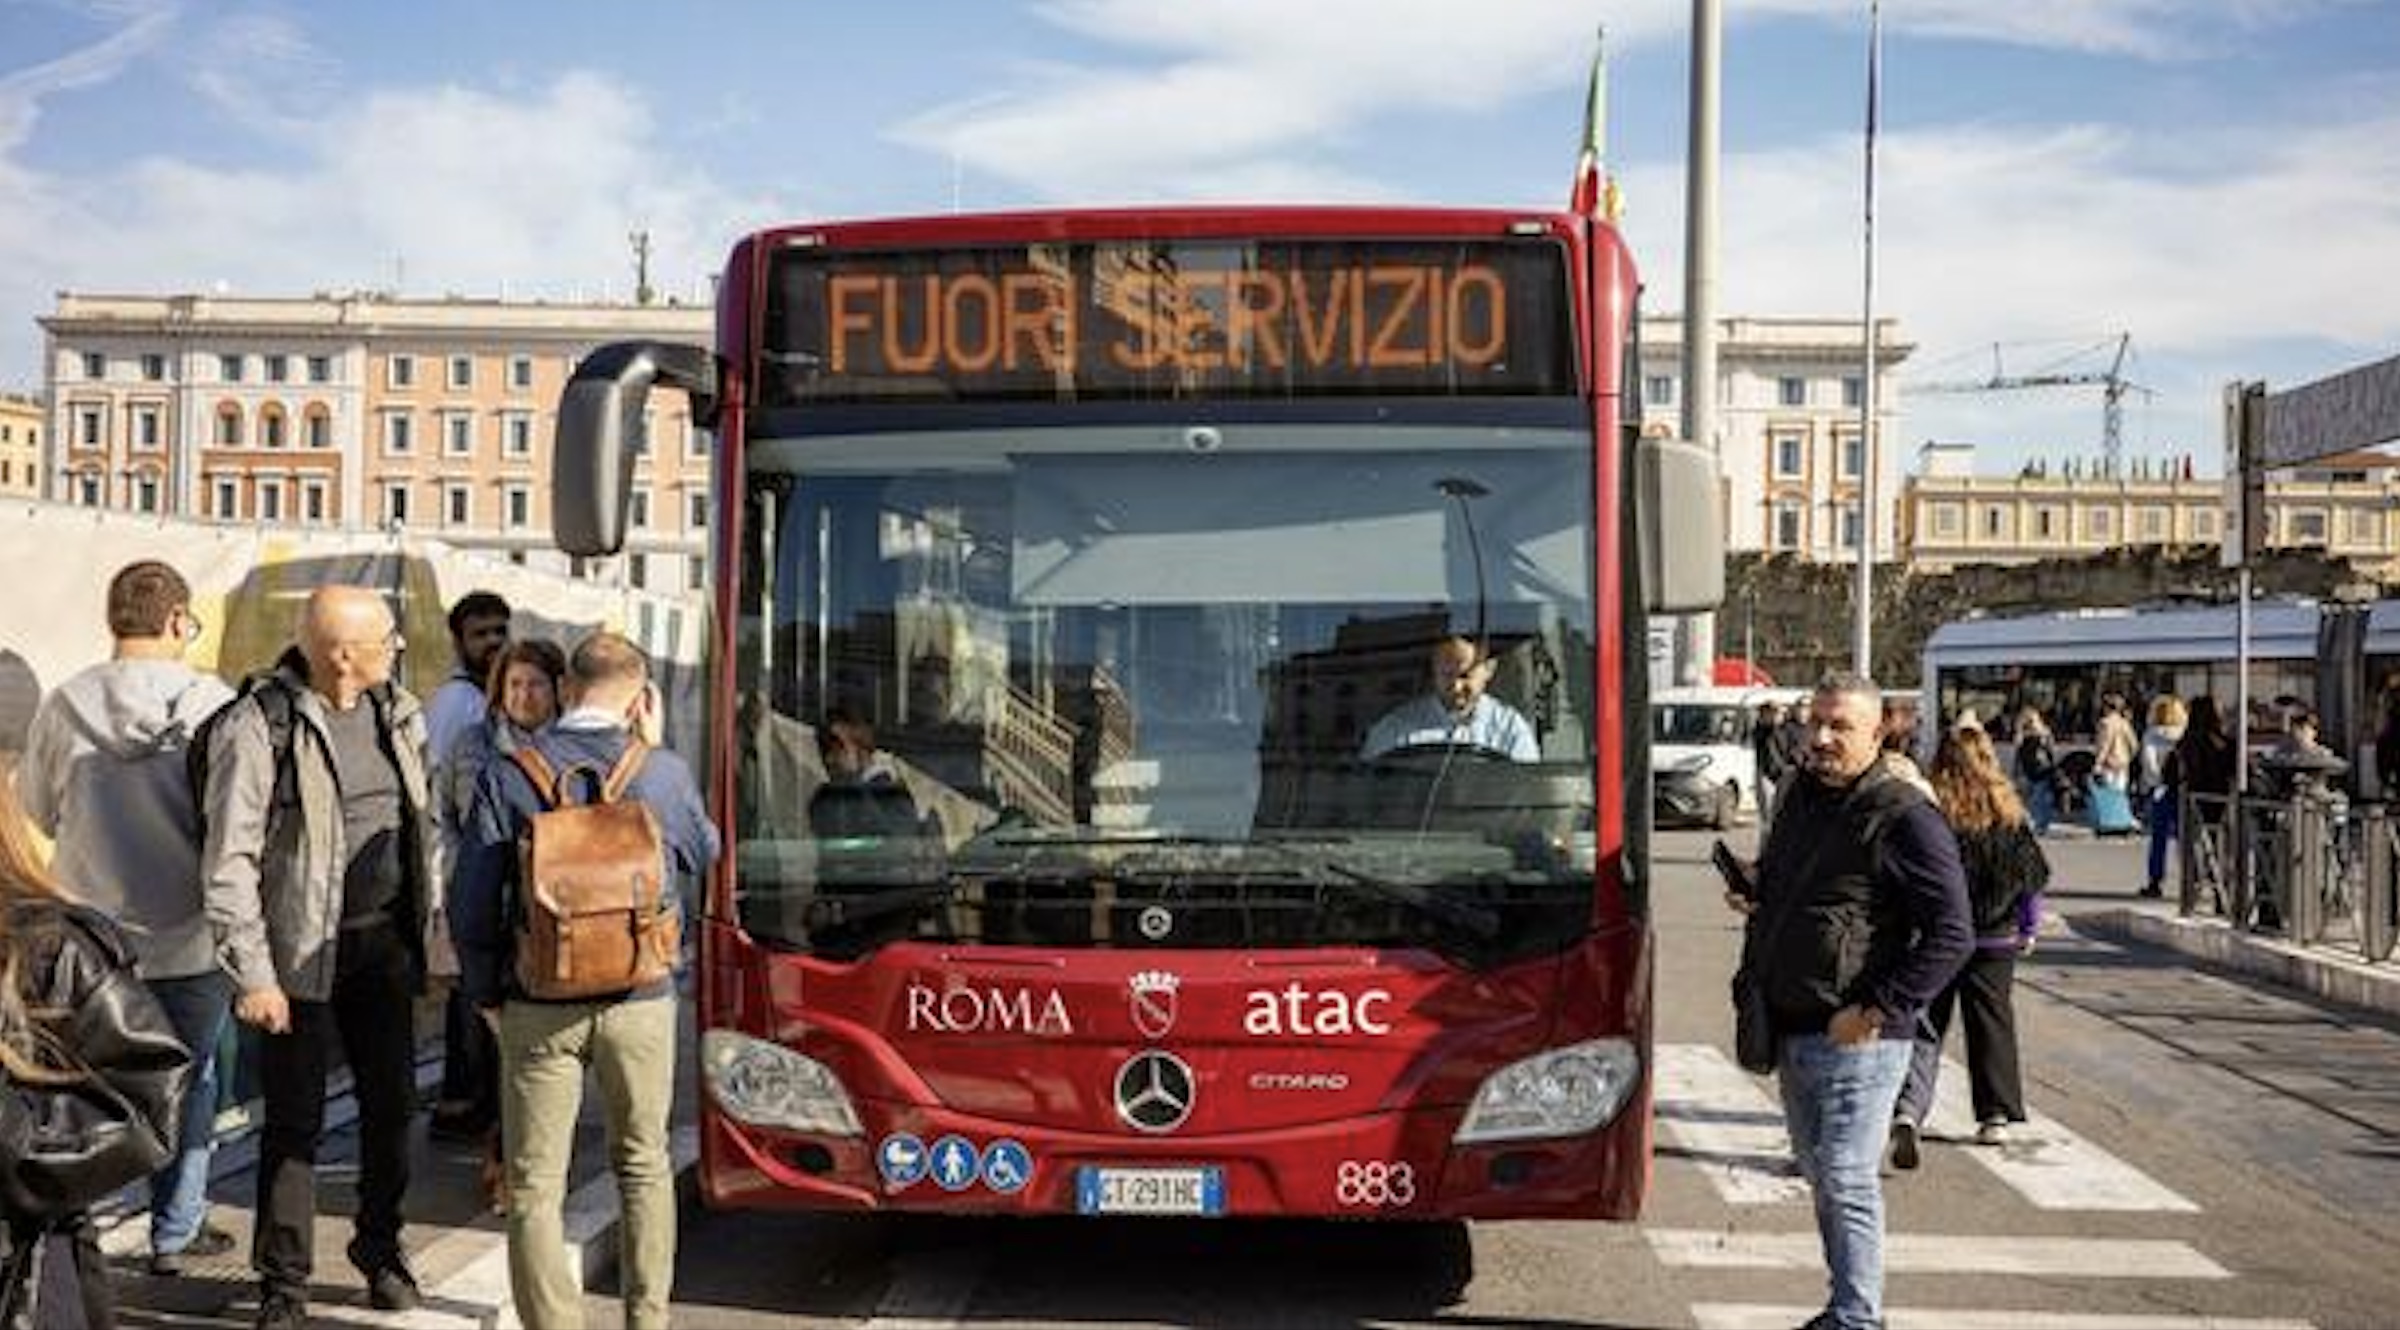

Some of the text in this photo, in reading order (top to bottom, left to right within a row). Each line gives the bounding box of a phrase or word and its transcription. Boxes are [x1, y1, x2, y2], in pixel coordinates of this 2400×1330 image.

[829, 265, 1506, 372] FUORI SERVIZIO
[906, 986, 1074, 1035] ROMA
[1244, 982, 1392, 1035] atac
[1248, 1073, 1350, 1090] CITARO
[1337, 1160, 1416, 1207] 883
